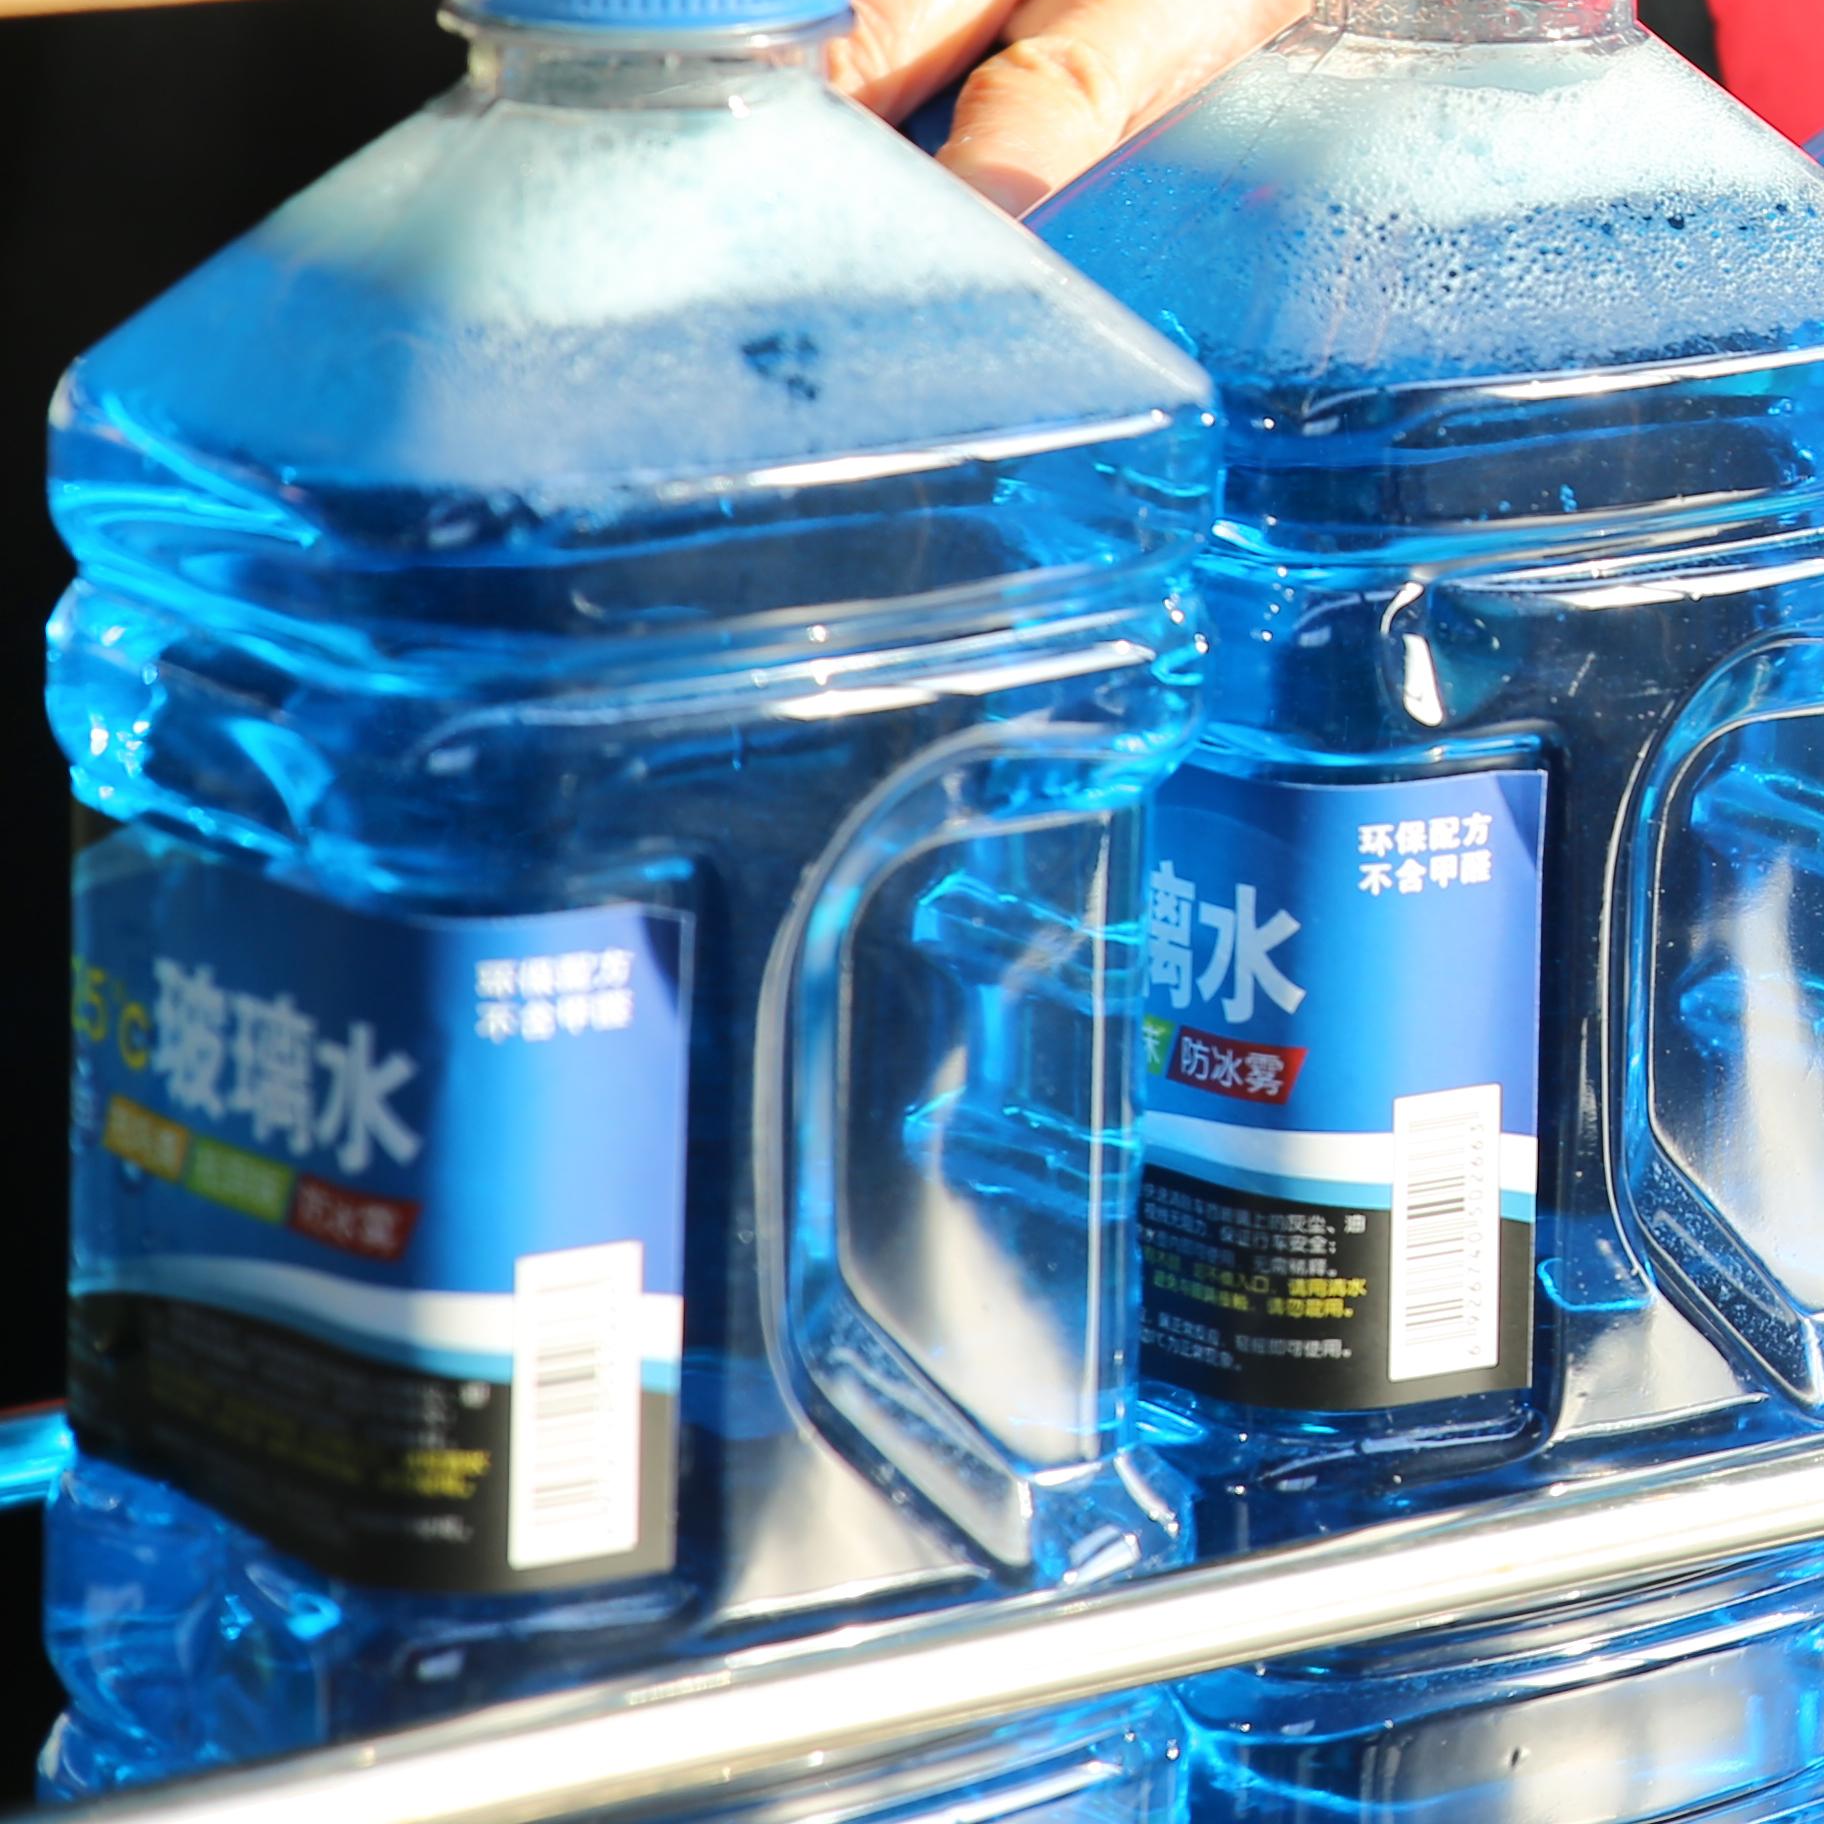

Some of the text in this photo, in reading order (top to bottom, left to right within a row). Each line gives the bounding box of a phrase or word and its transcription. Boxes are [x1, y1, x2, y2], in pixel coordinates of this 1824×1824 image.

[1357, 811, 1493, 858] 环保配方
[1357, 849, 1493, 896] 不含甲醛
[153, 956, 420, 1174] 玻璃水
[1181, 1036, 1284, 1096] 防冰雾
